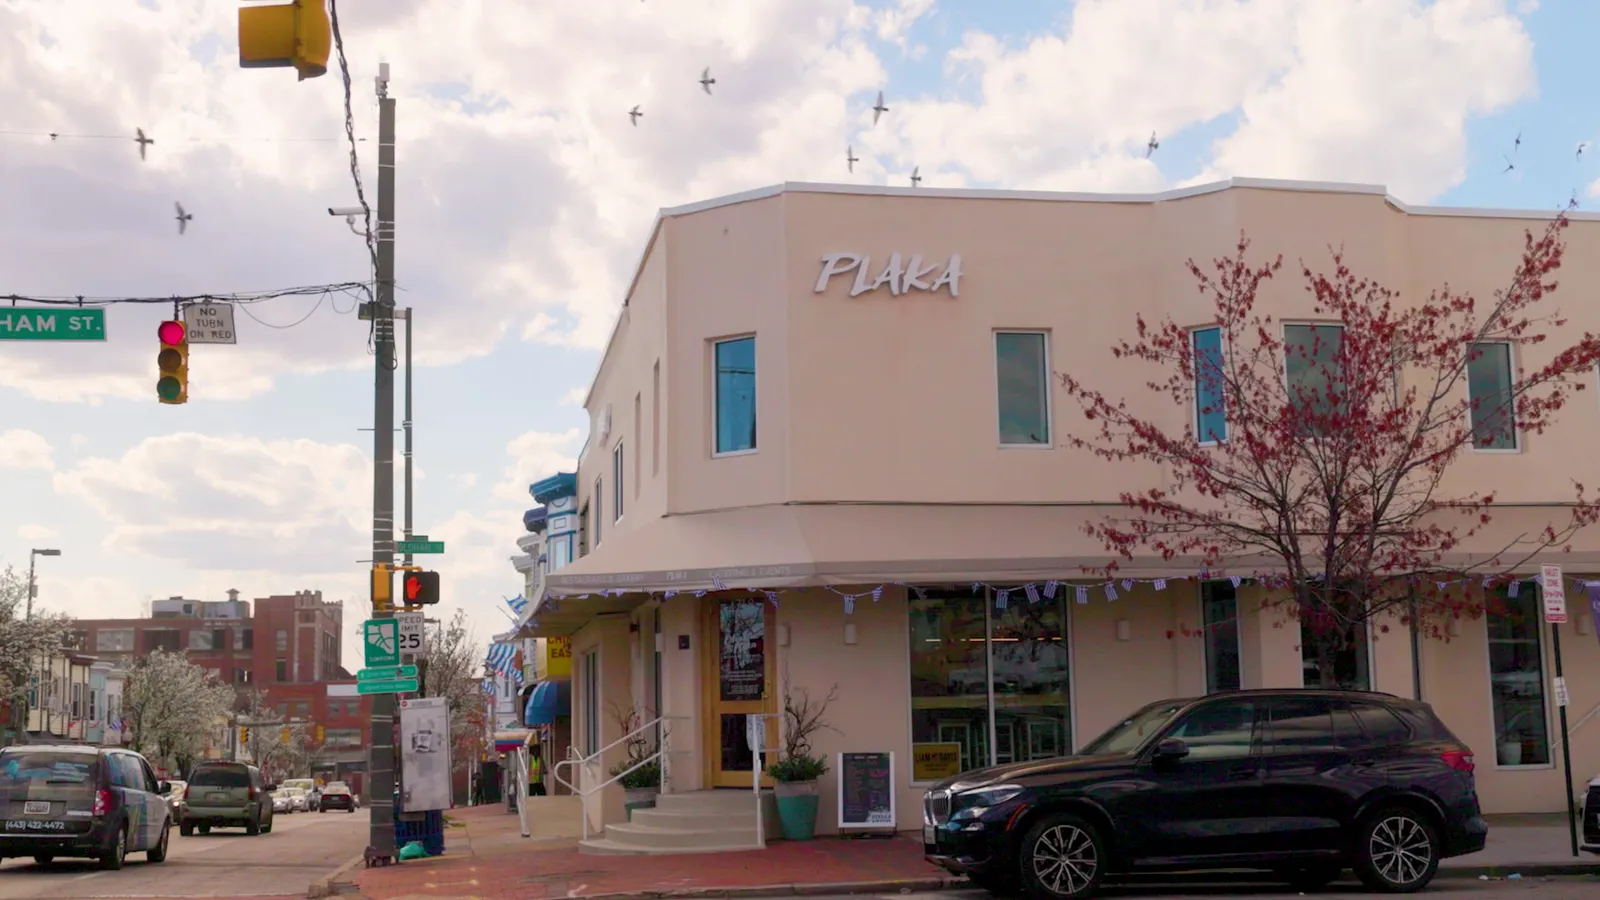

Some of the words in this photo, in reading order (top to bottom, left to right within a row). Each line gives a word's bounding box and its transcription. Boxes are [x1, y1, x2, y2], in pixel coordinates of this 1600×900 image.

[814, 252, 964, 297] PLAKA
[200, 308, 217, 316] NO
[69, 316, 100, 331] ST.
[196, 318, 224, 328] TURN
[190, 330, 205, 339] ON
[210, 330, 232, 339] RED
[399, 616, 422, 624] PEED
[400, 633, 420, 649] 25
[5, 821, 26, 830] (443)
